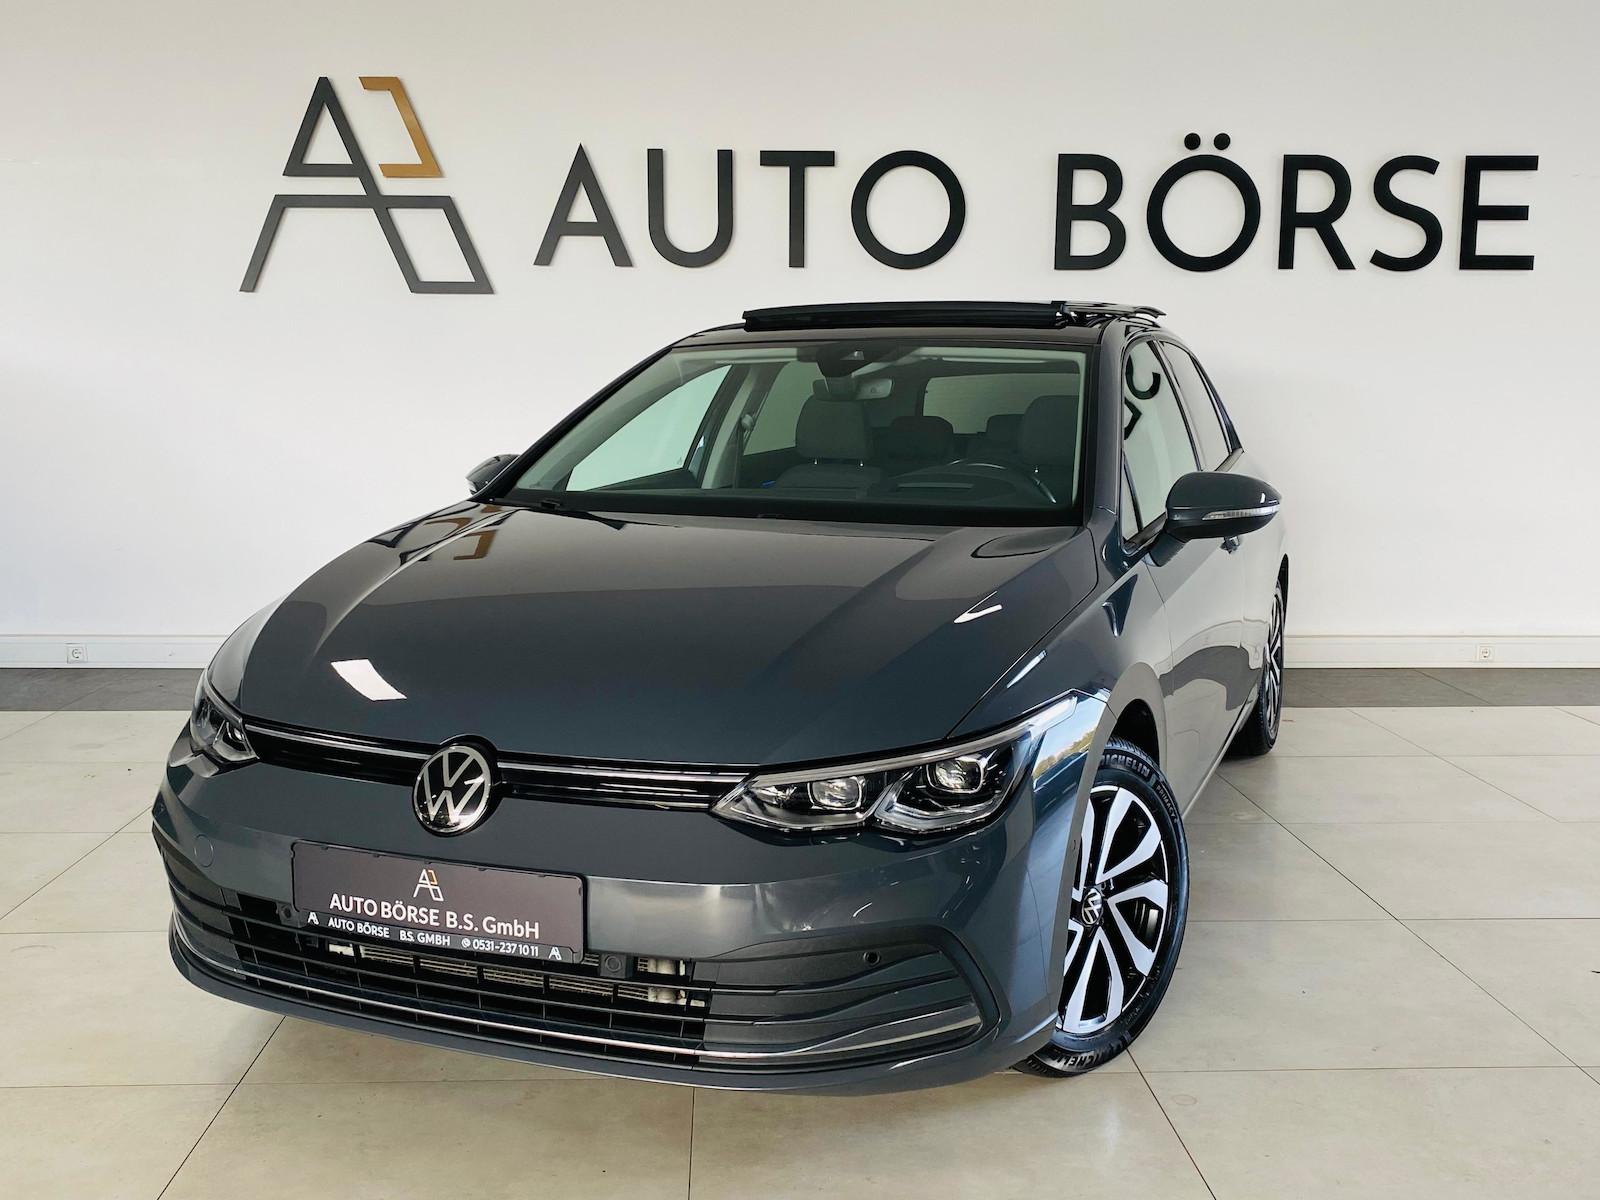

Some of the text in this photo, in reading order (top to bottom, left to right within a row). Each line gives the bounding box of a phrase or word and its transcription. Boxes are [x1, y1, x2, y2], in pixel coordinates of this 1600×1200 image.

[533, 132, 1539, 272] AUTO BÖRSE
[328, 917, 355, 932] AUTO
[356, 921, 391, 938] BÖRSE
[416, 932, 451, 947] GMBH
[329, 893, 540, 940] AUTO BÖRSE B.S. GmbH
